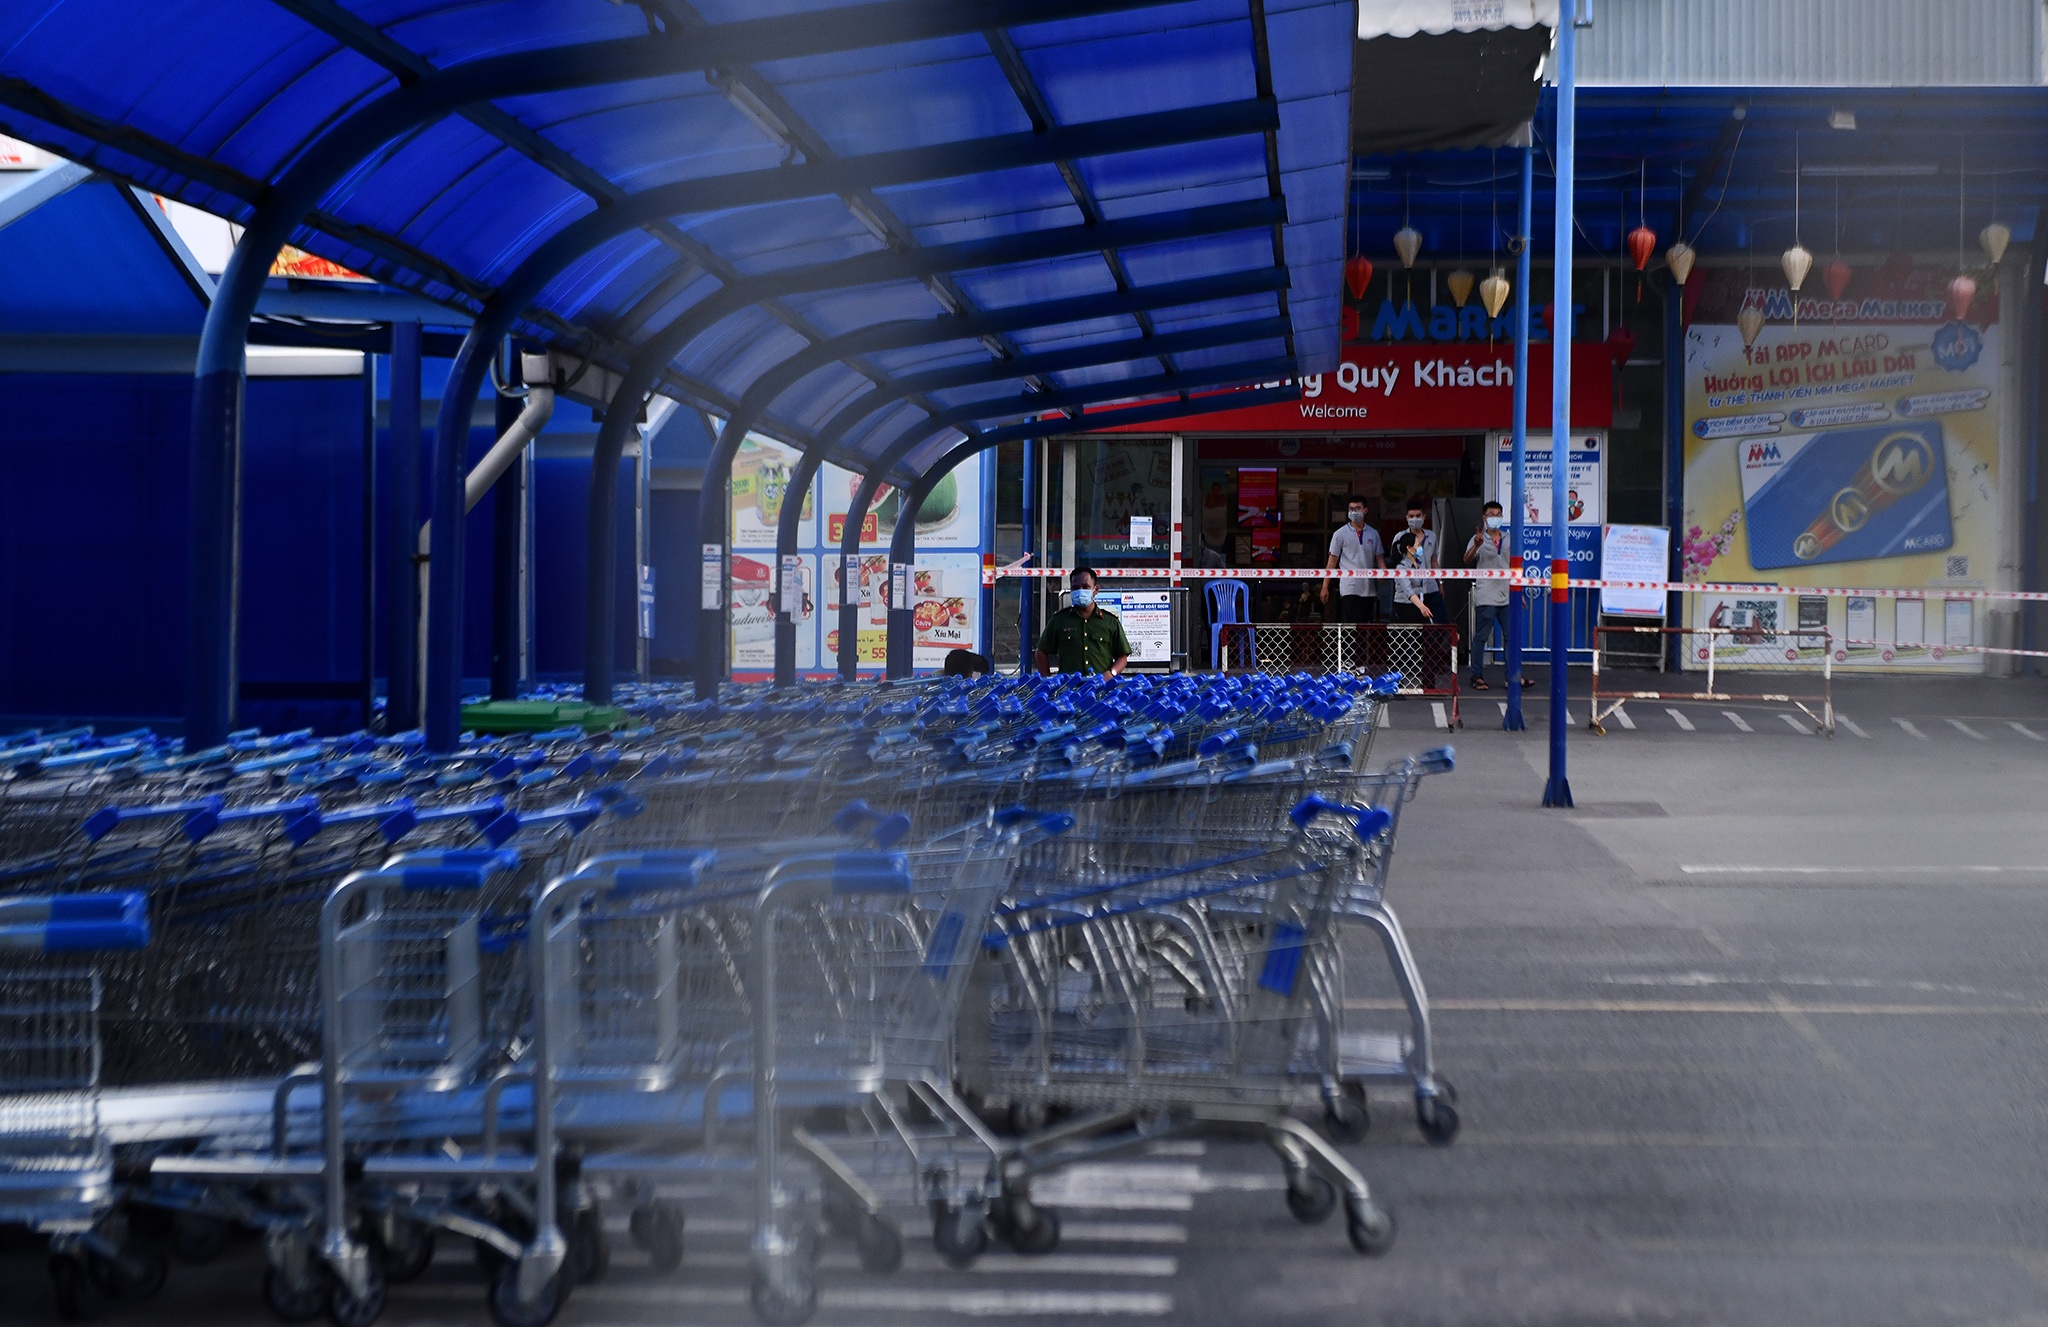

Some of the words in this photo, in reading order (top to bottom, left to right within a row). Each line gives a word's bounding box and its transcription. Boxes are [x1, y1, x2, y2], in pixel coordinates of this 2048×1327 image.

[1776, 343, 1812, 362] APP
[1336, 360, 1400, 397] Quý
[1413, 358, 1514, 388] Khách
[1769, 366, 1799, 389] LỢI
[1805, 361, 1836, 383] ÍCH
[1842, 356, 1877, 379] LÂU
[1883, 353, 1916, 374] DÀI
[1789, 386, 1812, 398] VIÊN
[1815, 387, 1833, 396] MM
[1836, 382, 1866, 393] MEGA
[1870, 375, 1915, 388] MARKET
[1300, 404, 1367, 418] Welcome
[1523, 528, 1541, 537] Cửa
[1569, 528, 1592, 540] Ngày
[1568, 550, 1594, 561] 2:00
